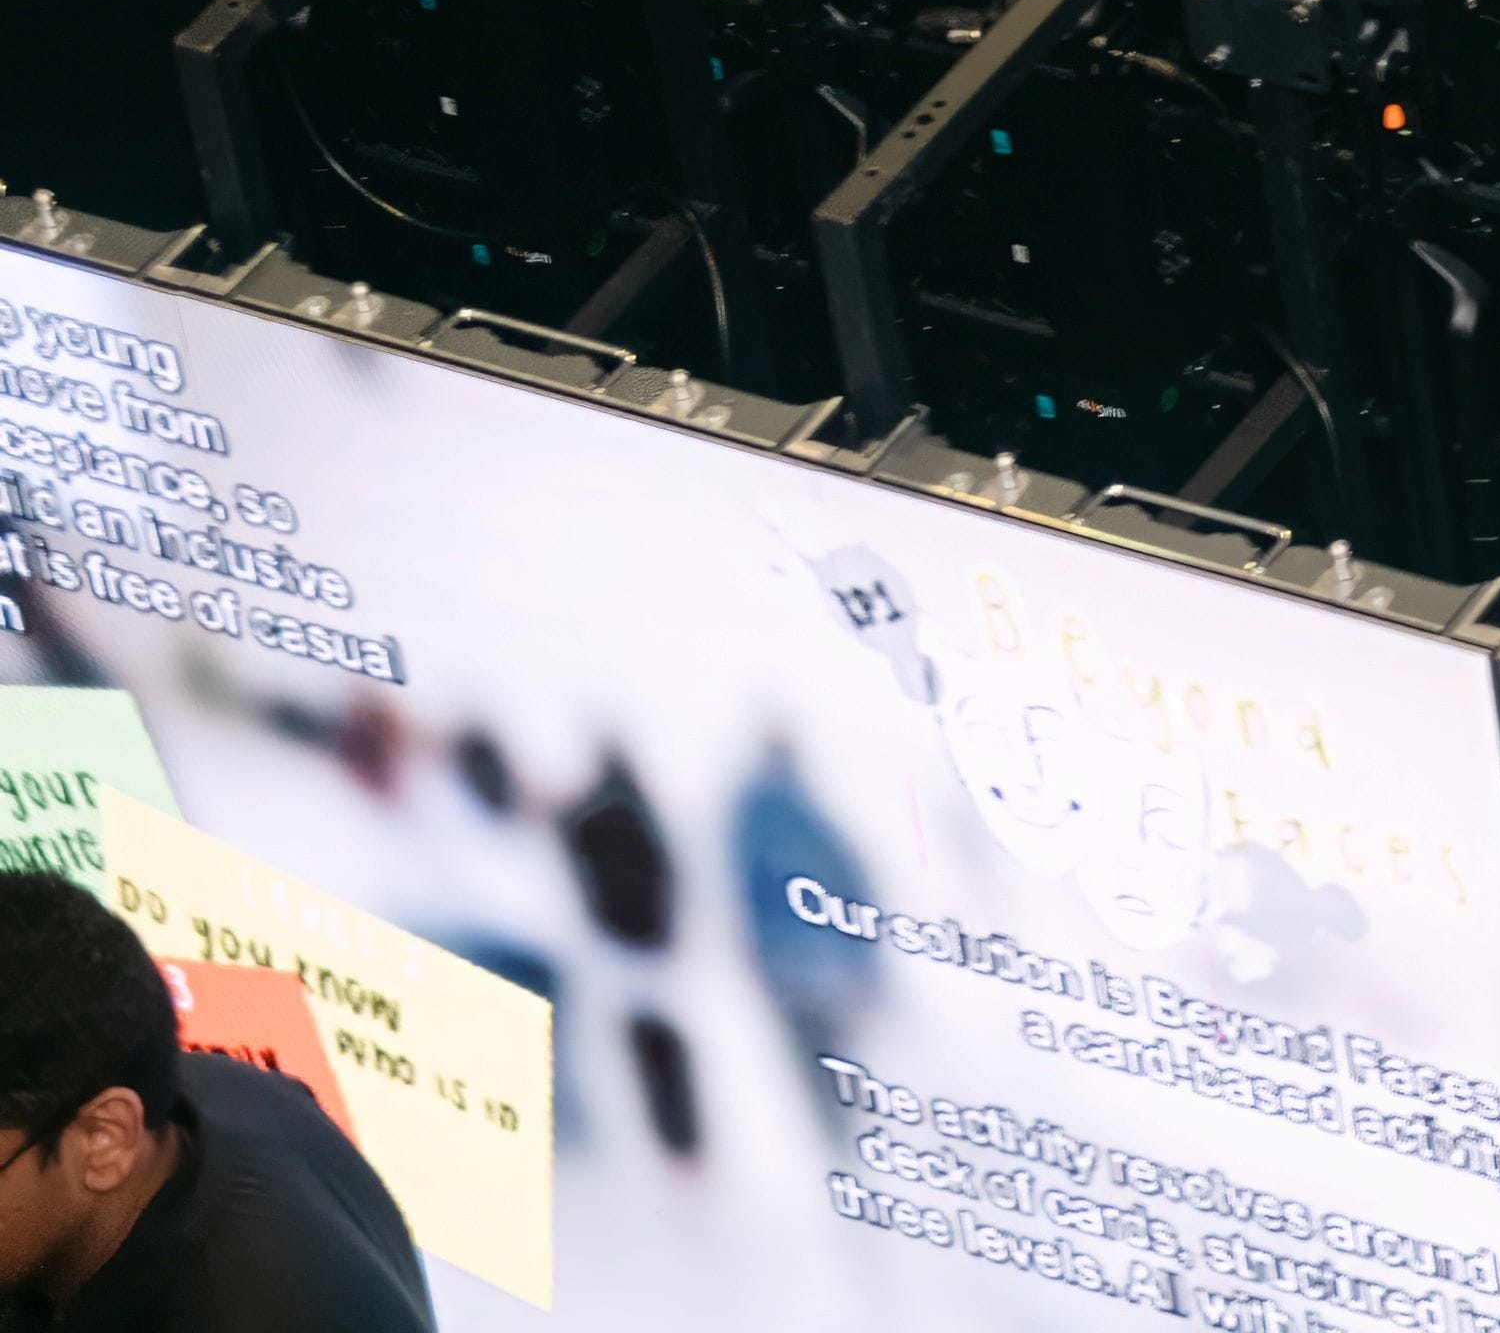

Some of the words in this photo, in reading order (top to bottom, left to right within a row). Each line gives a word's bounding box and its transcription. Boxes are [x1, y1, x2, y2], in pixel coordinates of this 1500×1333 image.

[22, 304, 186, 396] young
[111, 380, 229, 457] from
[72, 499, 139, 552] an
[140, 505, 354, 611] inclusive
[234, 482, 299, 536] so
[32, 535, 82, 592] is
[83, 550, 186, 621] free
[189, 587, 241, 638] of
[249, 605, 406, 686] casual
[972, 566, 1336, 776] Beyond
[0, 767, 99, 823] your
[192, 914, 273, 969] you
[786, 874, 881, 942] Our
[889, 914, 1083, 1001] solution
[1090, 959, 1138, 1017] is
[1142, 974, 1336, 1072] Beyond
[435, 1073, 469, 1112] is
[1019, 1009, 1059, 1053] a
[1065, 1023, 1344, 1135] card-based
[818, 1053, 921, 1125] The
[932, 1098, 1096, 1185] activity
[1109, 1148, 1312, 1241] revolves
[1321, 1212, 1500, 1296] around
[858, 1126, 980, 1200] deck
[984, 1168, 1036, 1216] of
[1043, 1189, 1194, 1270] cards,
[1202, 1233, 1446, 1329] structured
[828, 1170, 954, 1248] three
[1126, 1259, 1190, 1318] AI
